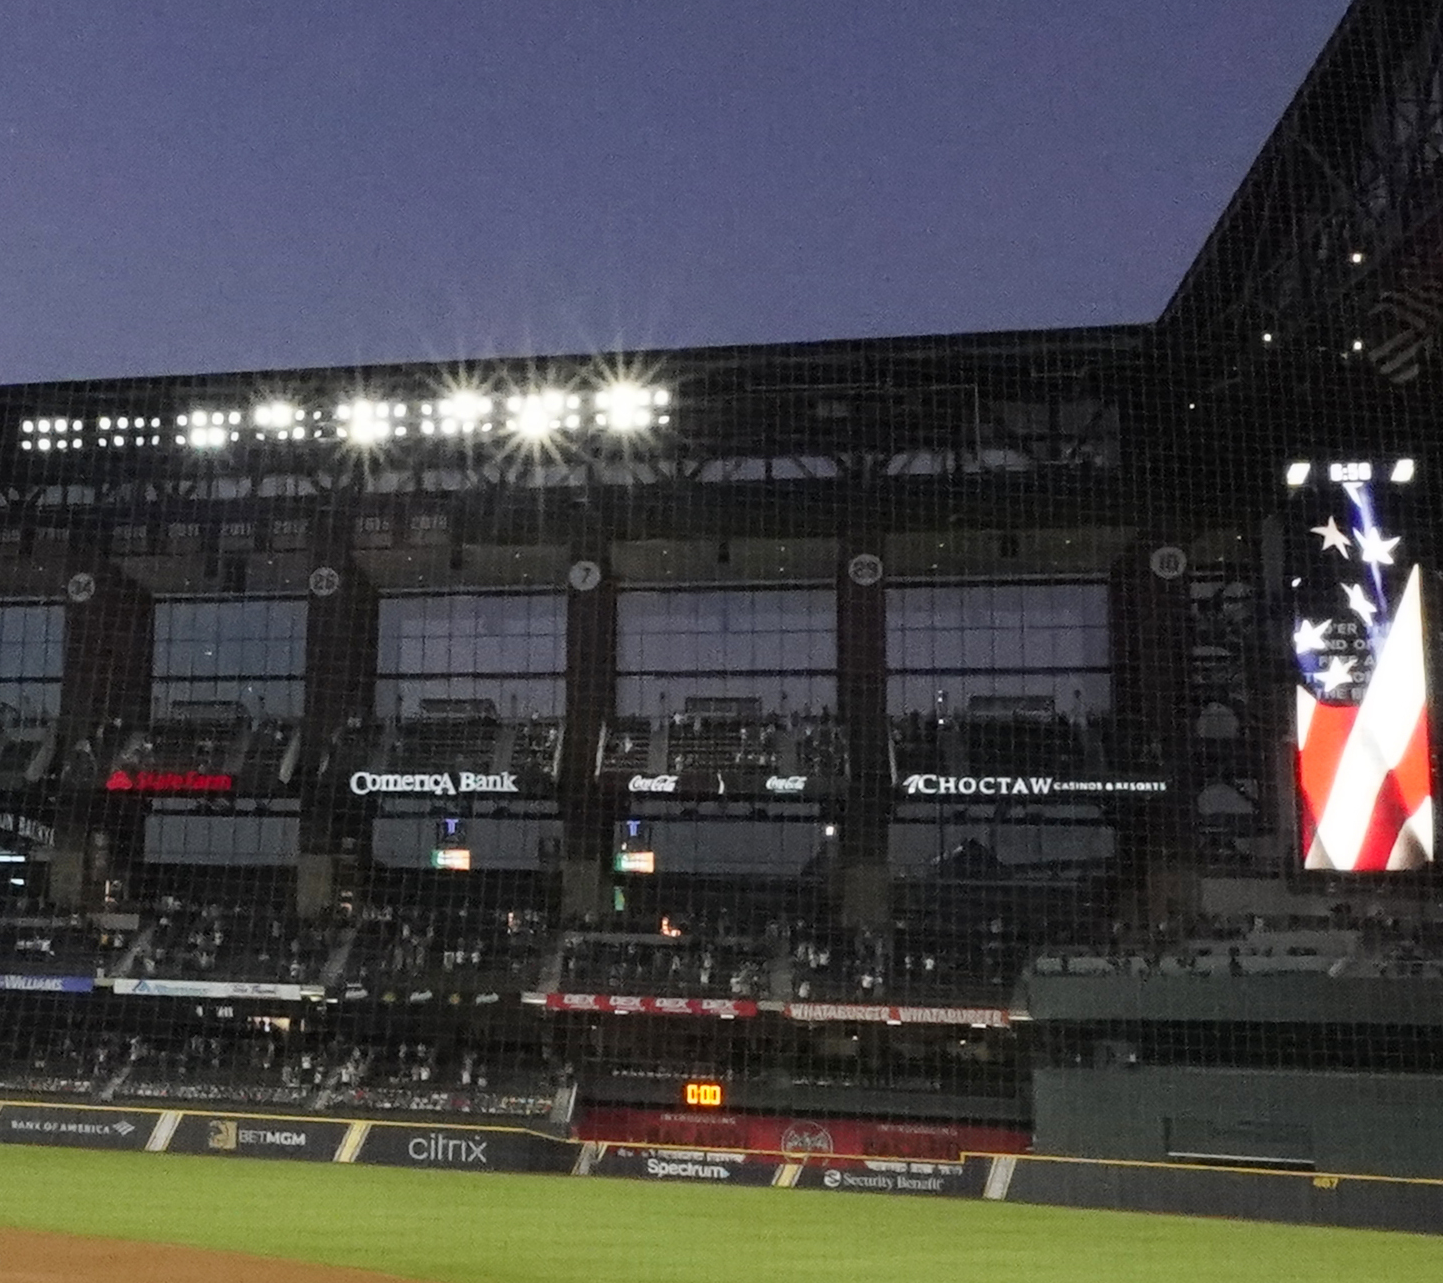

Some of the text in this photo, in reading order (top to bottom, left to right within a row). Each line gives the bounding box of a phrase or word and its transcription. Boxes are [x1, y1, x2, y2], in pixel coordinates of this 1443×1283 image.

[582, 567, 591, 584] 7
[853, 561, 878, 580] 29
[136, 771, 232, 790] State Farm
[458, 771, 518, 793] Bank
[918, 774, 1053, 795] CHOCTAW
[1053, 781, 1103, 791] CASINOS
[1115, 781, 1167, 792] RESORTS
[789, 1004, 890, 1021] WHATABURGER
[11, 1120, 111, 1135] BANK OF AMERICA
[239, 1129, 306, 1146] BETMGM
[408, 1133, 487, 1164] citrix
[647, 1157, 725, 1180] Spectrum
[842, 1172, 944, 1191] Security Benefit
